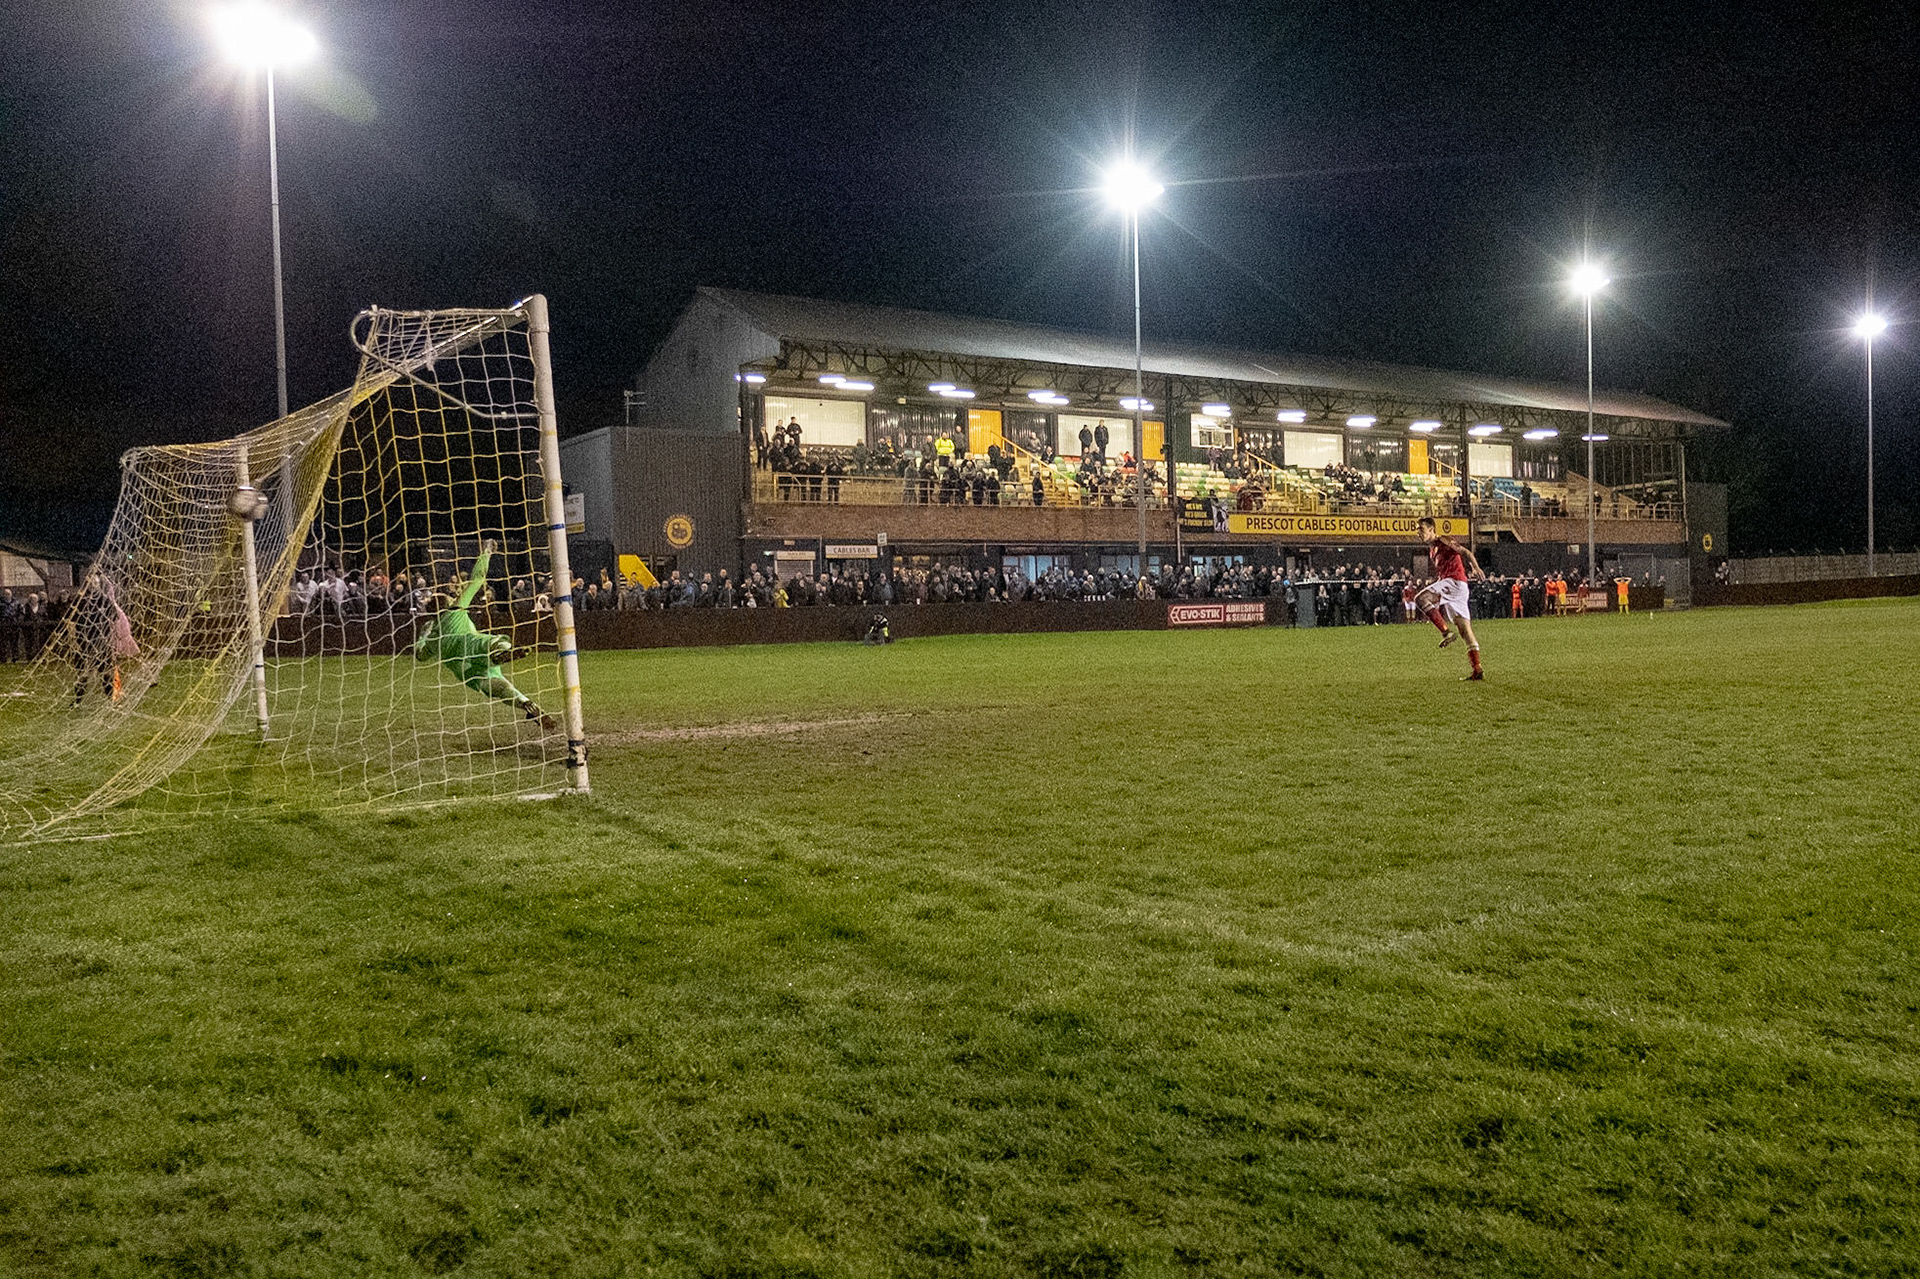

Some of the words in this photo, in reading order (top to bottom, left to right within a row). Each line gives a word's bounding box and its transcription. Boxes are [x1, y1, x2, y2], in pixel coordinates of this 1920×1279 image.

[1246, 517, 1294, 530] PRESCOT
[1297, 517, 1336, 531] CABLES
[1339, 519, 1390, 532] FOOTBALL
[1393, 520, 1416, 532] CLUB
[1226, 604, 1264, 613] ADHESIVES
[1180, 609, 1220, 619] EVO-STIK
